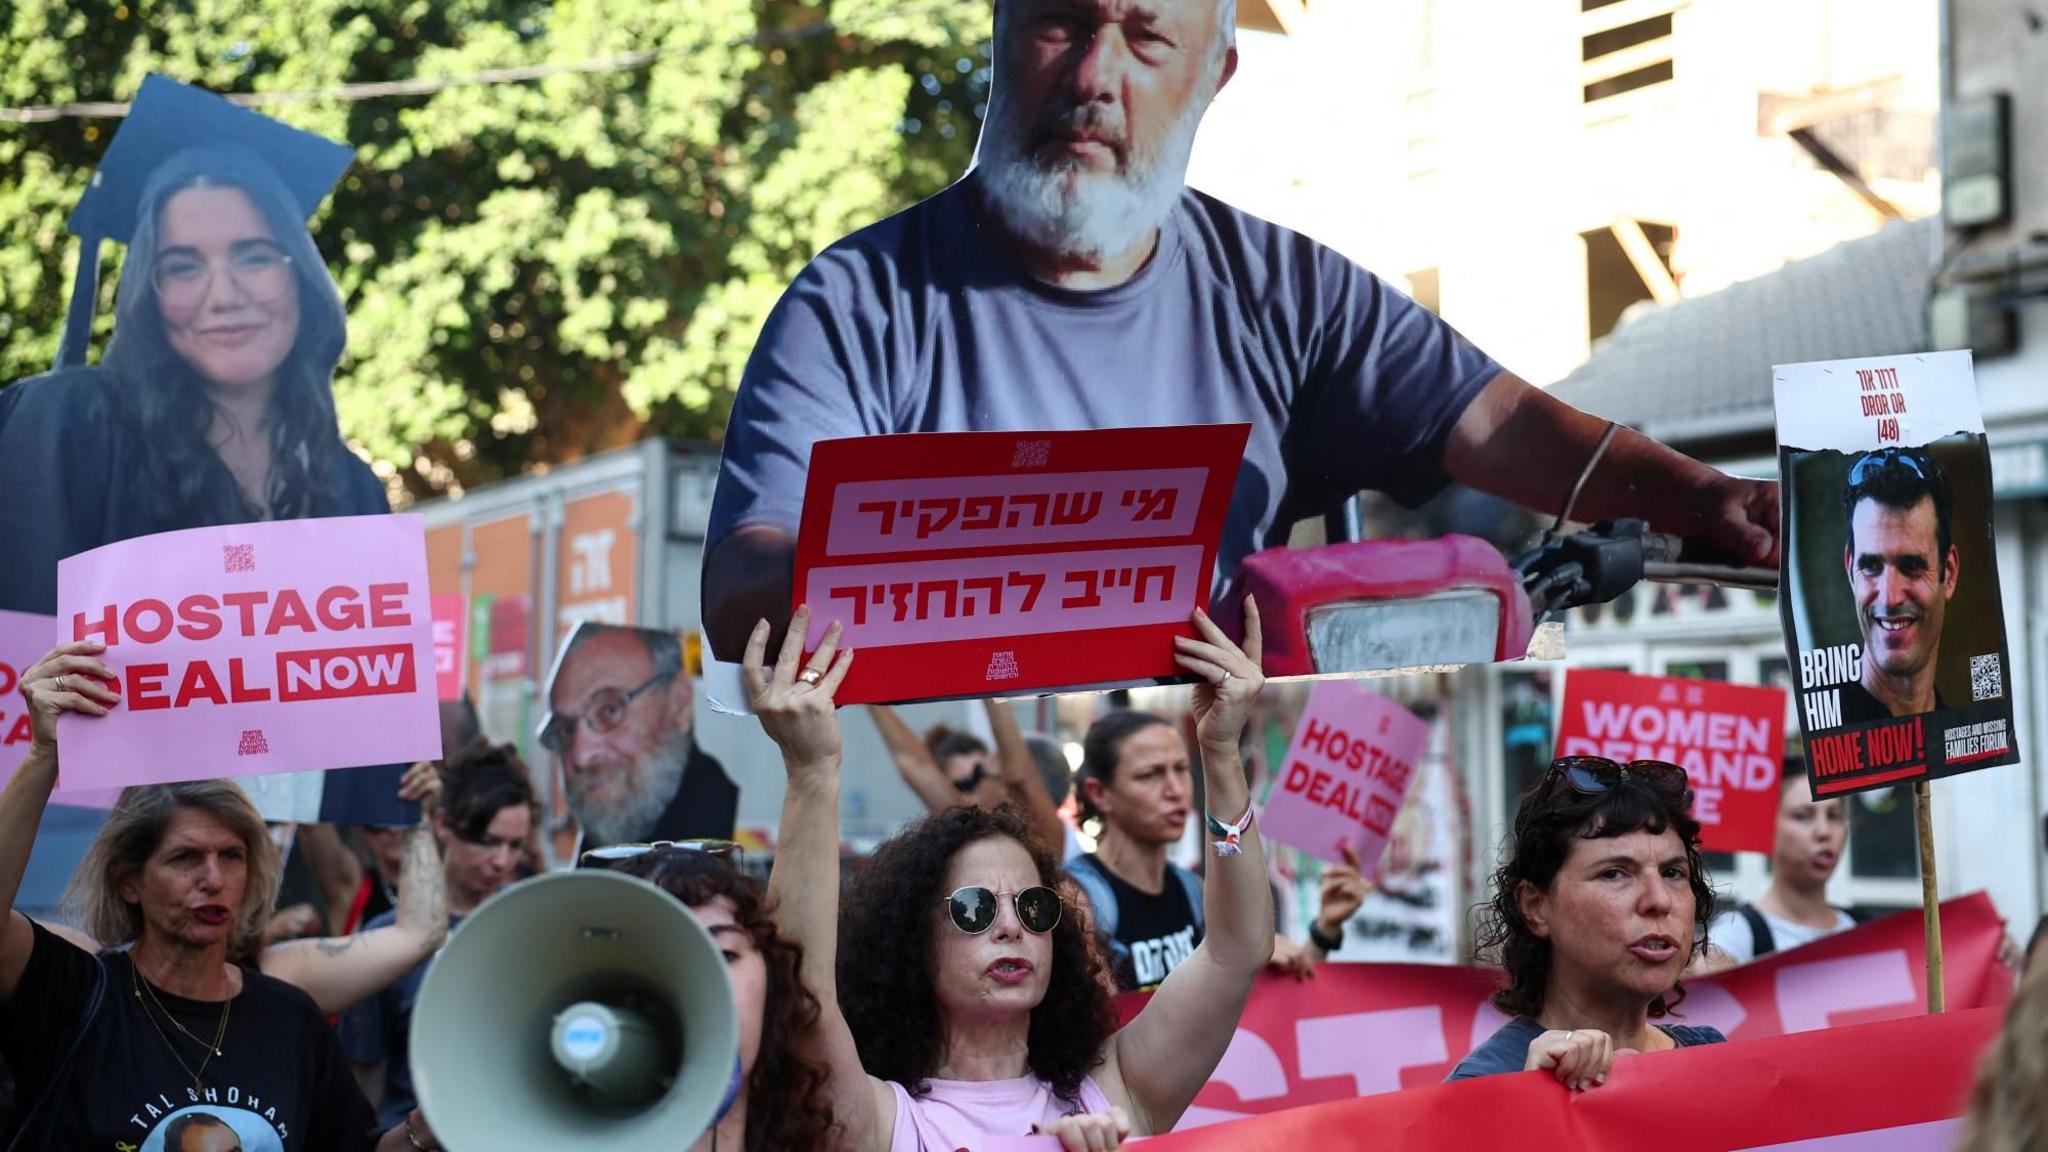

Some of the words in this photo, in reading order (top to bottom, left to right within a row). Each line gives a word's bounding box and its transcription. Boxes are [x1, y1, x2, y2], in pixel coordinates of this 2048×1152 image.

[1856, 369, 1877, 391] אור
[1875, 368, 1899, 390] דרור
[1861, 394, 1890, 417] DROR
[1890, 393, 1907, 414] OR
[1877, 417, 1900, 444] (48)
[858, 491, 1103, 539] שהפקיר
[1120, 488, 1179, 521] מי
[830, 571, 1046, 625] להחזיר
[1062, 565, 1176, 609] חייב
[73, 582, 412, 646] HOSTAGE
[286, 652, 404, 693] NOW
[1800, 643, 1861, 689] BRING
[1582, 700, 1770, 753] WOMEN
[1803, 689, 1842, 731] HIM
[1944, 725, 1971, 741] HOSTAGES
[1972, 723, 1982, 736] AND
[1983, 718, 2006, 734] MISSING
[1810, 730, 1864, 777] HOME
[1867, 716, 1925, 767] NOW!
[1945, 737, 1979, 759] FAMILIES
[1980, 731, 2007, 753] FORUM
[1284, 761, 1361, 821] DEAL
[130, 1094, 175, 1129] TAL
[186, 1086, 289, 1139] SHOHAM
